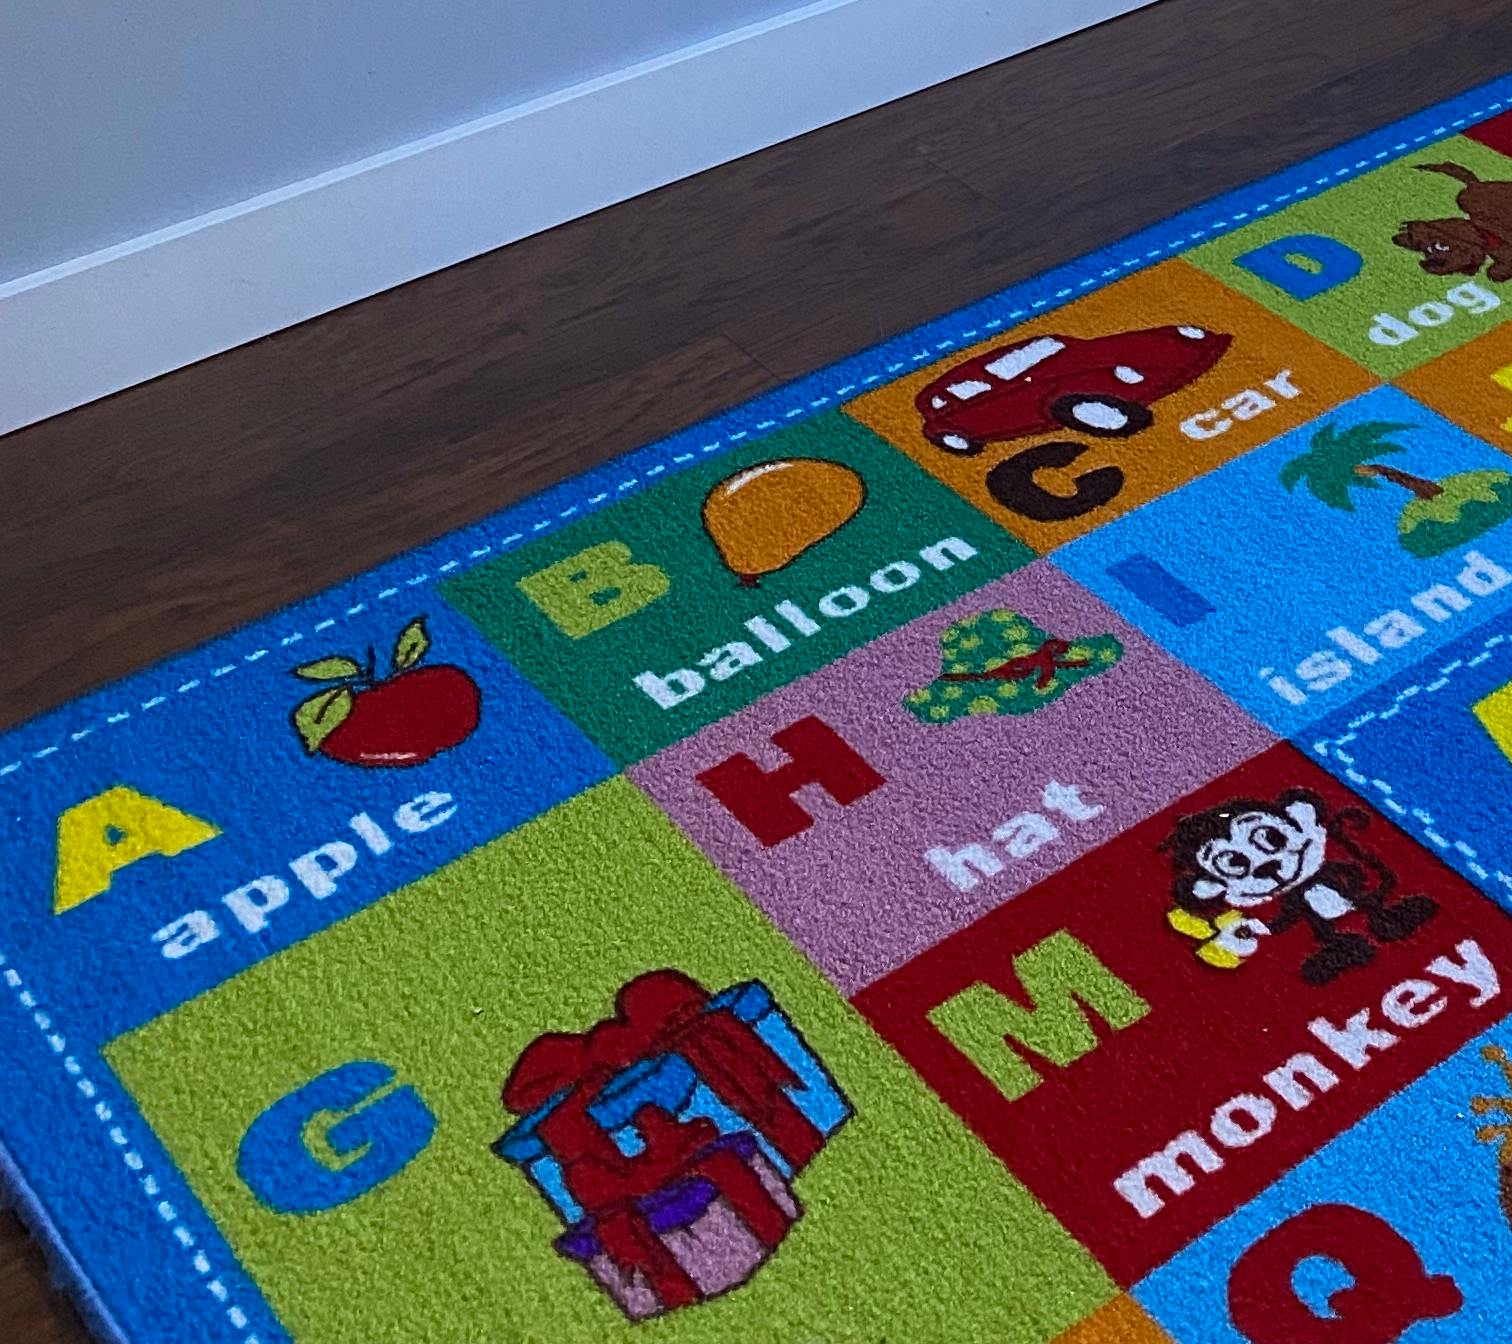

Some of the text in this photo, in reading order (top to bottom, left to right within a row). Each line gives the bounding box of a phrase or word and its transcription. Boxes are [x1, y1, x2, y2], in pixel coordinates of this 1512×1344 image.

[1367, 278, 1502, 347] dog
[1179, 367, 1305, 444] car
[630, 532, 980, 712] balloon
[54, 784, 224, 915] A
[151, 789, 458, 959] apple
[923, 776, 1108, 893] hat
[924, 926, 1155, 1105] M
[1110, 935, 1506, 1222] monkey
